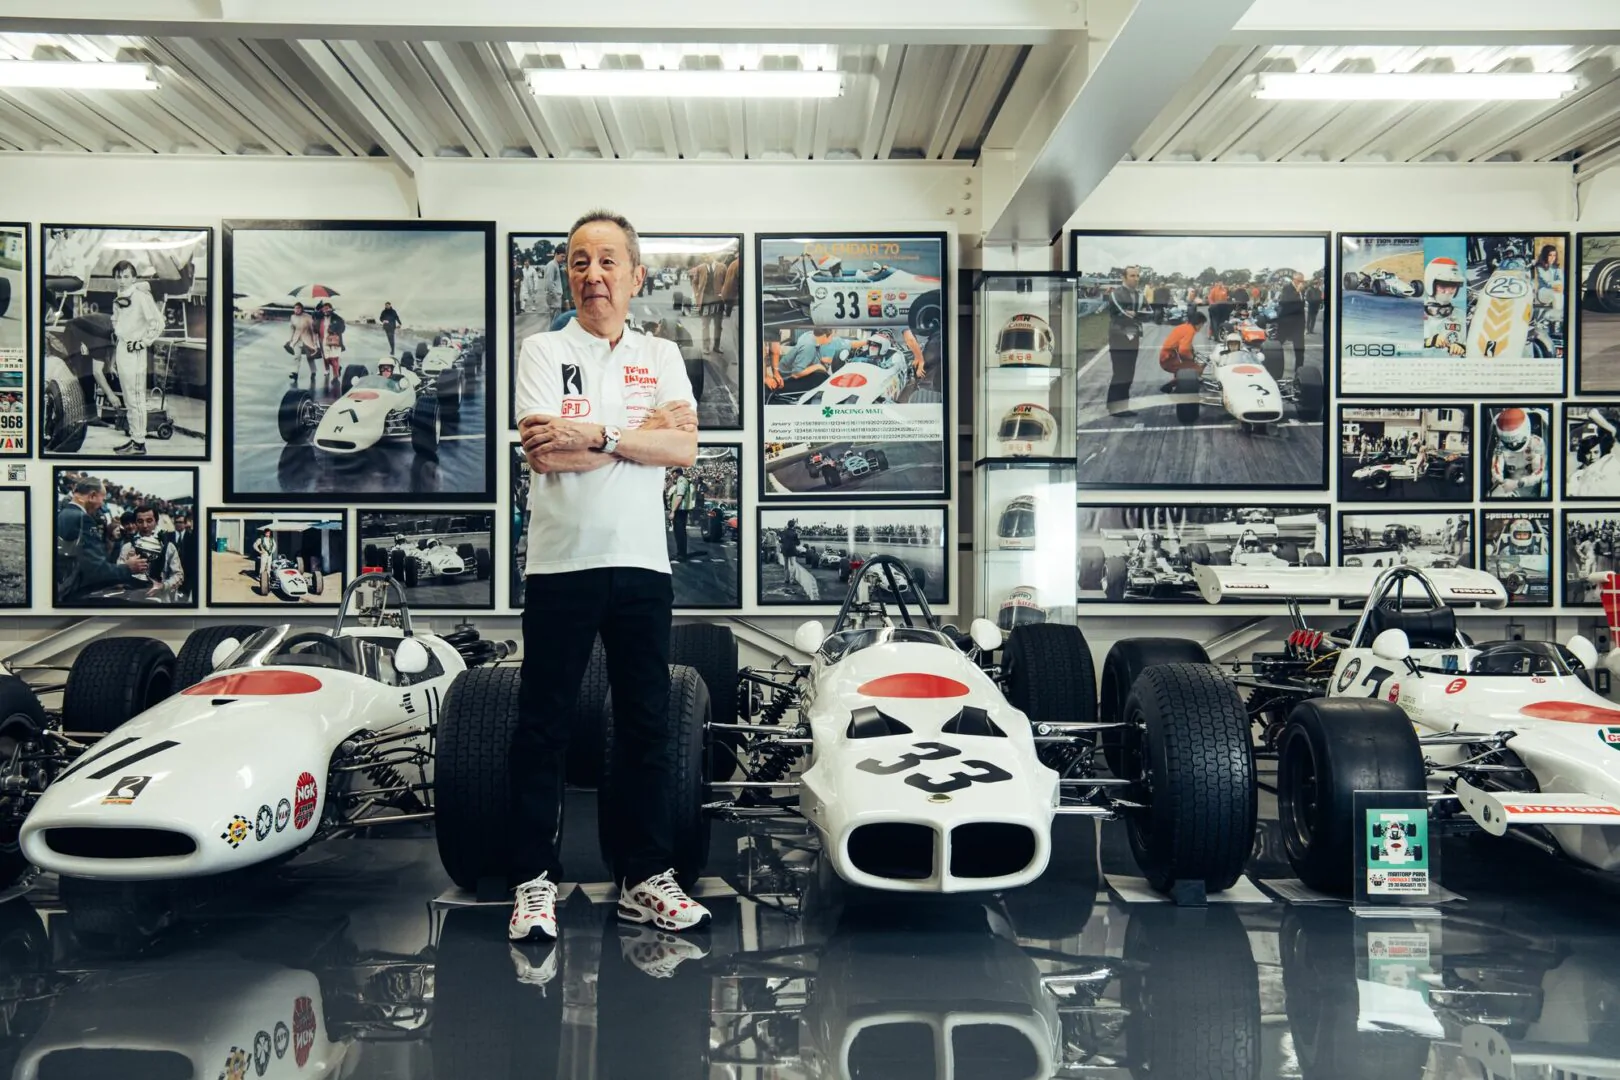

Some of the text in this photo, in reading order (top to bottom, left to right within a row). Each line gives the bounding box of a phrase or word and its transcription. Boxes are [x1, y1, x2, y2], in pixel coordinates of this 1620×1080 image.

[833, 291, 860, 319] 33
[1345, 344, 1396, 357] 1969
[338, 409, 359, 423] 7
[53, 737, 182, 784] 11
[855, 741, 1013, 793] 33
[297, 783, 315, 802] NGK
[1511, 805, 1611, 813] Firestone
